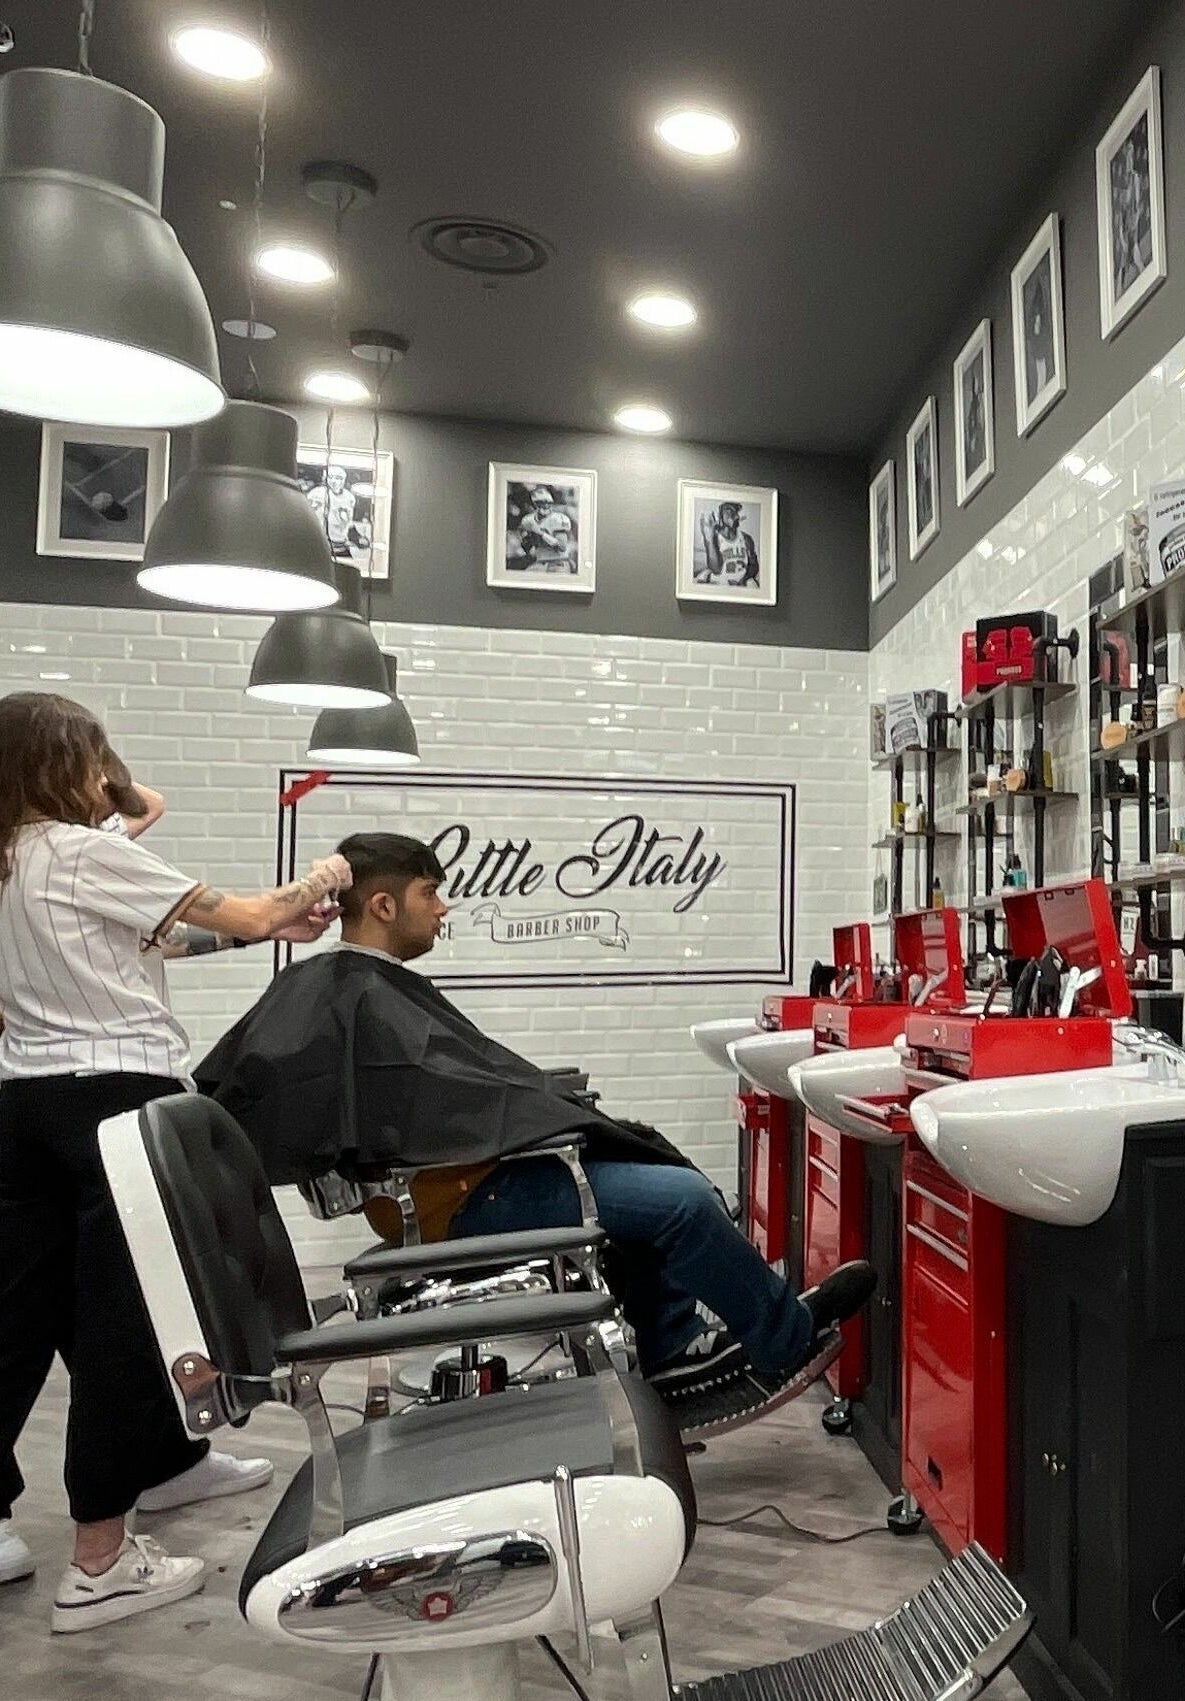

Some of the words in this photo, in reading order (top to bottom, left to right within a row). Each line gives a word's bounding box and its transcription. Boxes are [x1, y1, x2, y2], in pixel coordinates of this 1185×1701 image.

[555, 815, 728, 913] Italy
[507, 920, 560, 939] BARBER
[565, 915, 601, 934] SHOP
